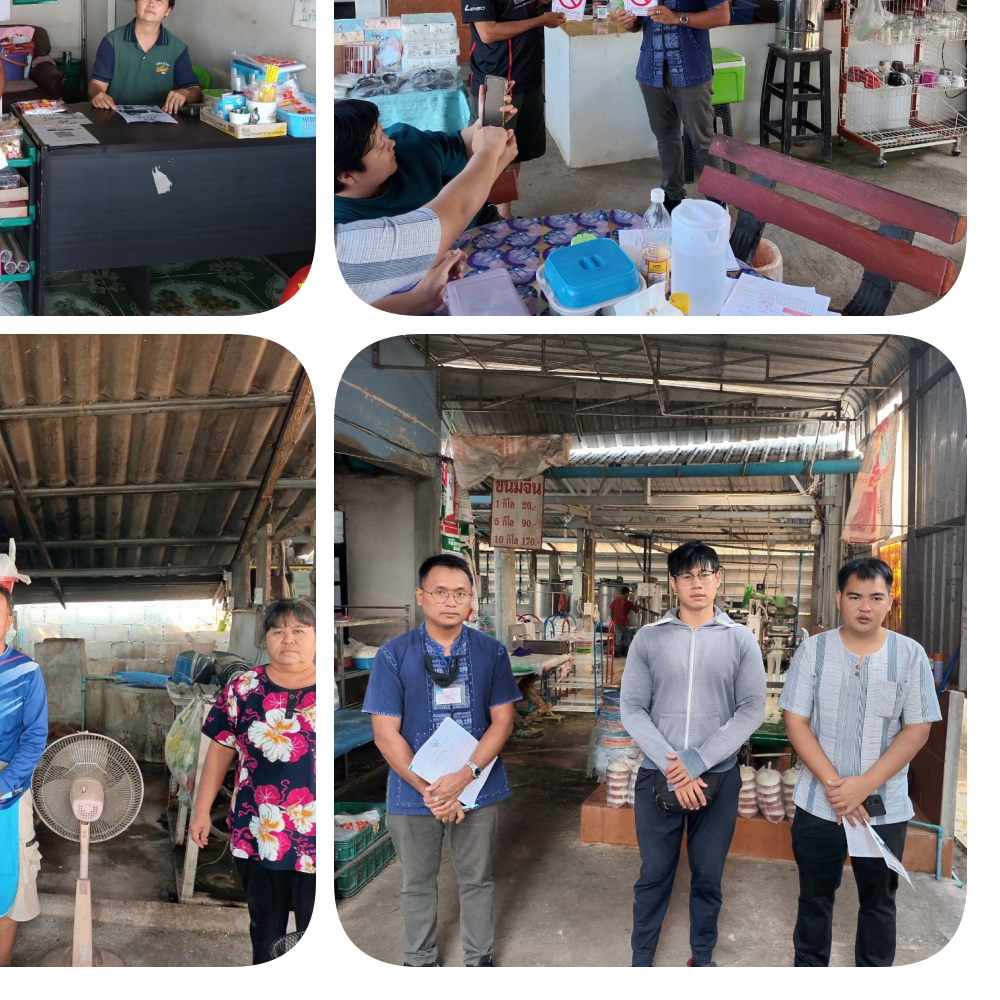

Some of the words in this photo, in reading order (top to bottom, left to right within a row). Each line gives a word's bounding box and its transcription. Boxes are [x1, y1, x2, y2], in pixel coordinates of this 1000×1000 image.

[495, 478, 542, 495] ขนมจีน
[496, 500, 500, 508] 1
[502, 498, 514, 508] กิโล
[522, 502, 536, 510] 20.-
[494, 518, 500, 526] 5
[502, 516, 514, 526] กิโล
[522, 520, 536, 528] 90.-
[494, 536, 504, 544] 10
[506, 534, 518, 544] กิโล
[522, 537, 540, 546] 170.-
